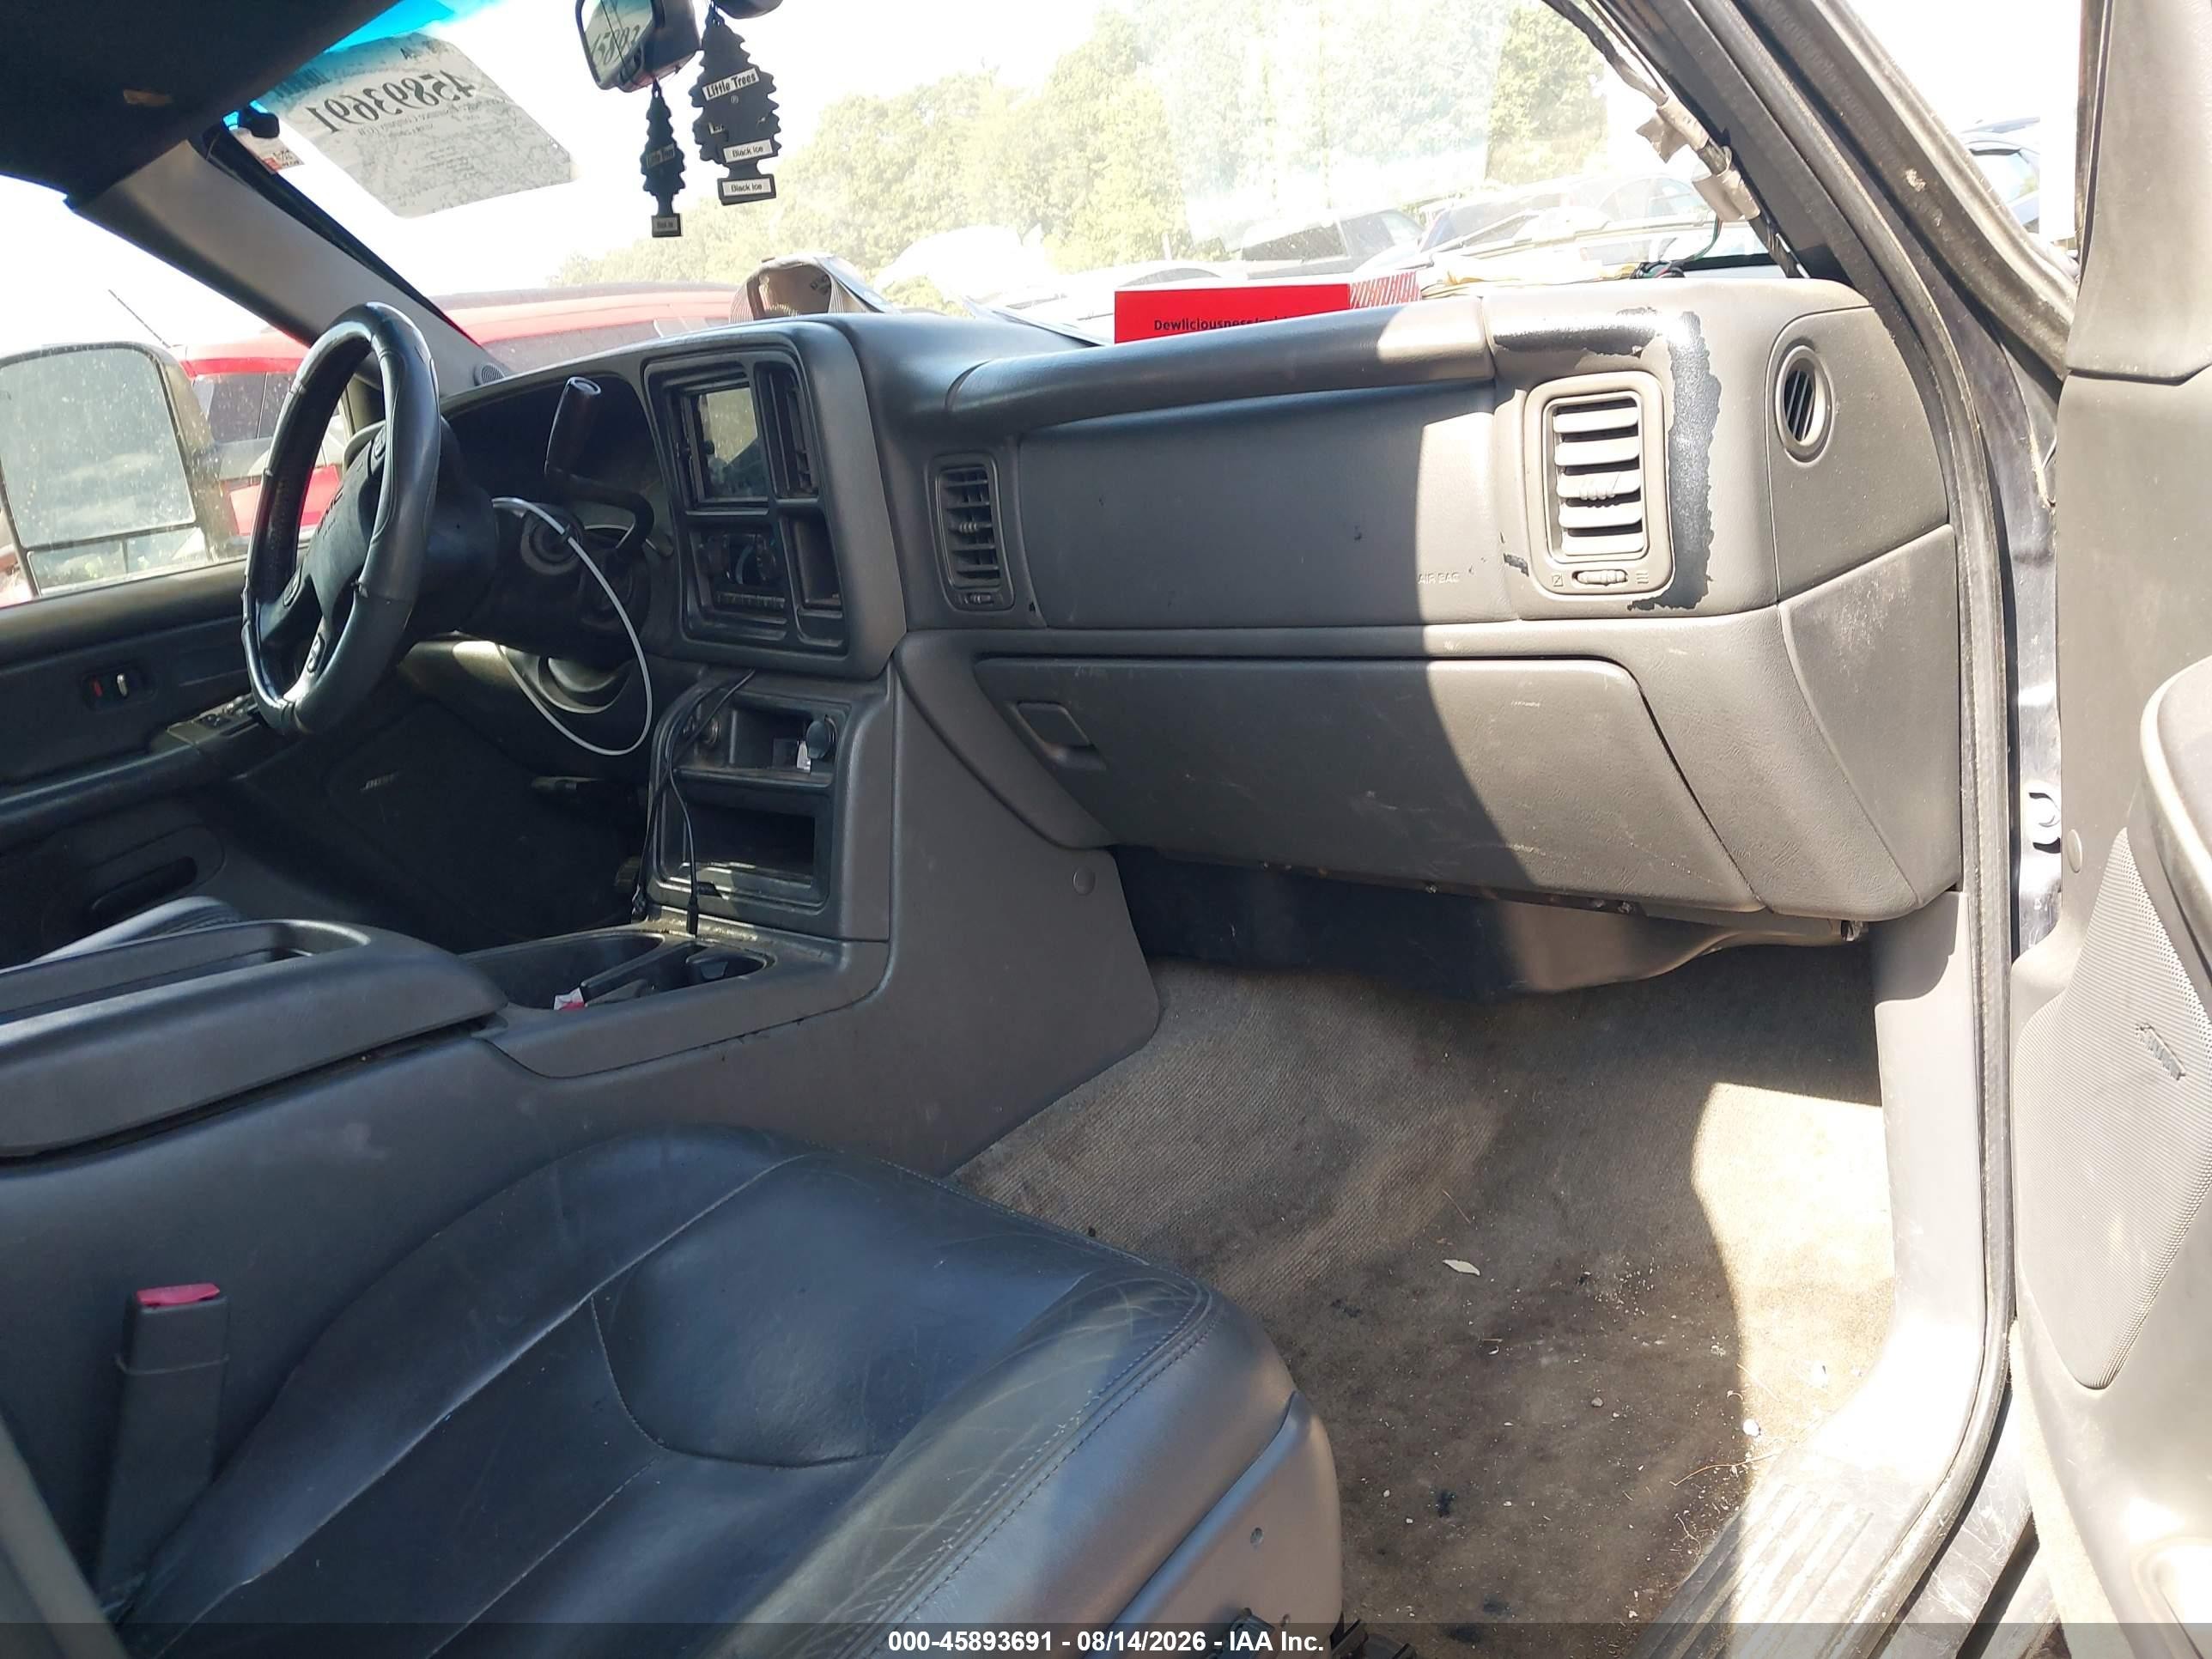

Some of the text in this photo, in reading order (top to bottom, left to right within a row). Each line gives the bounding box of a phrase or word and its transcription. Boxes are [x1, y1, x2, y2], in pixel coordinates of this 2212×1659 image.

[706, 72, 756, 98] Little Trees
[732, 146, 751, 158] Black
[731, 182, 763, 193] Black Ice
[1418, 573, 1437, 585] AIR
